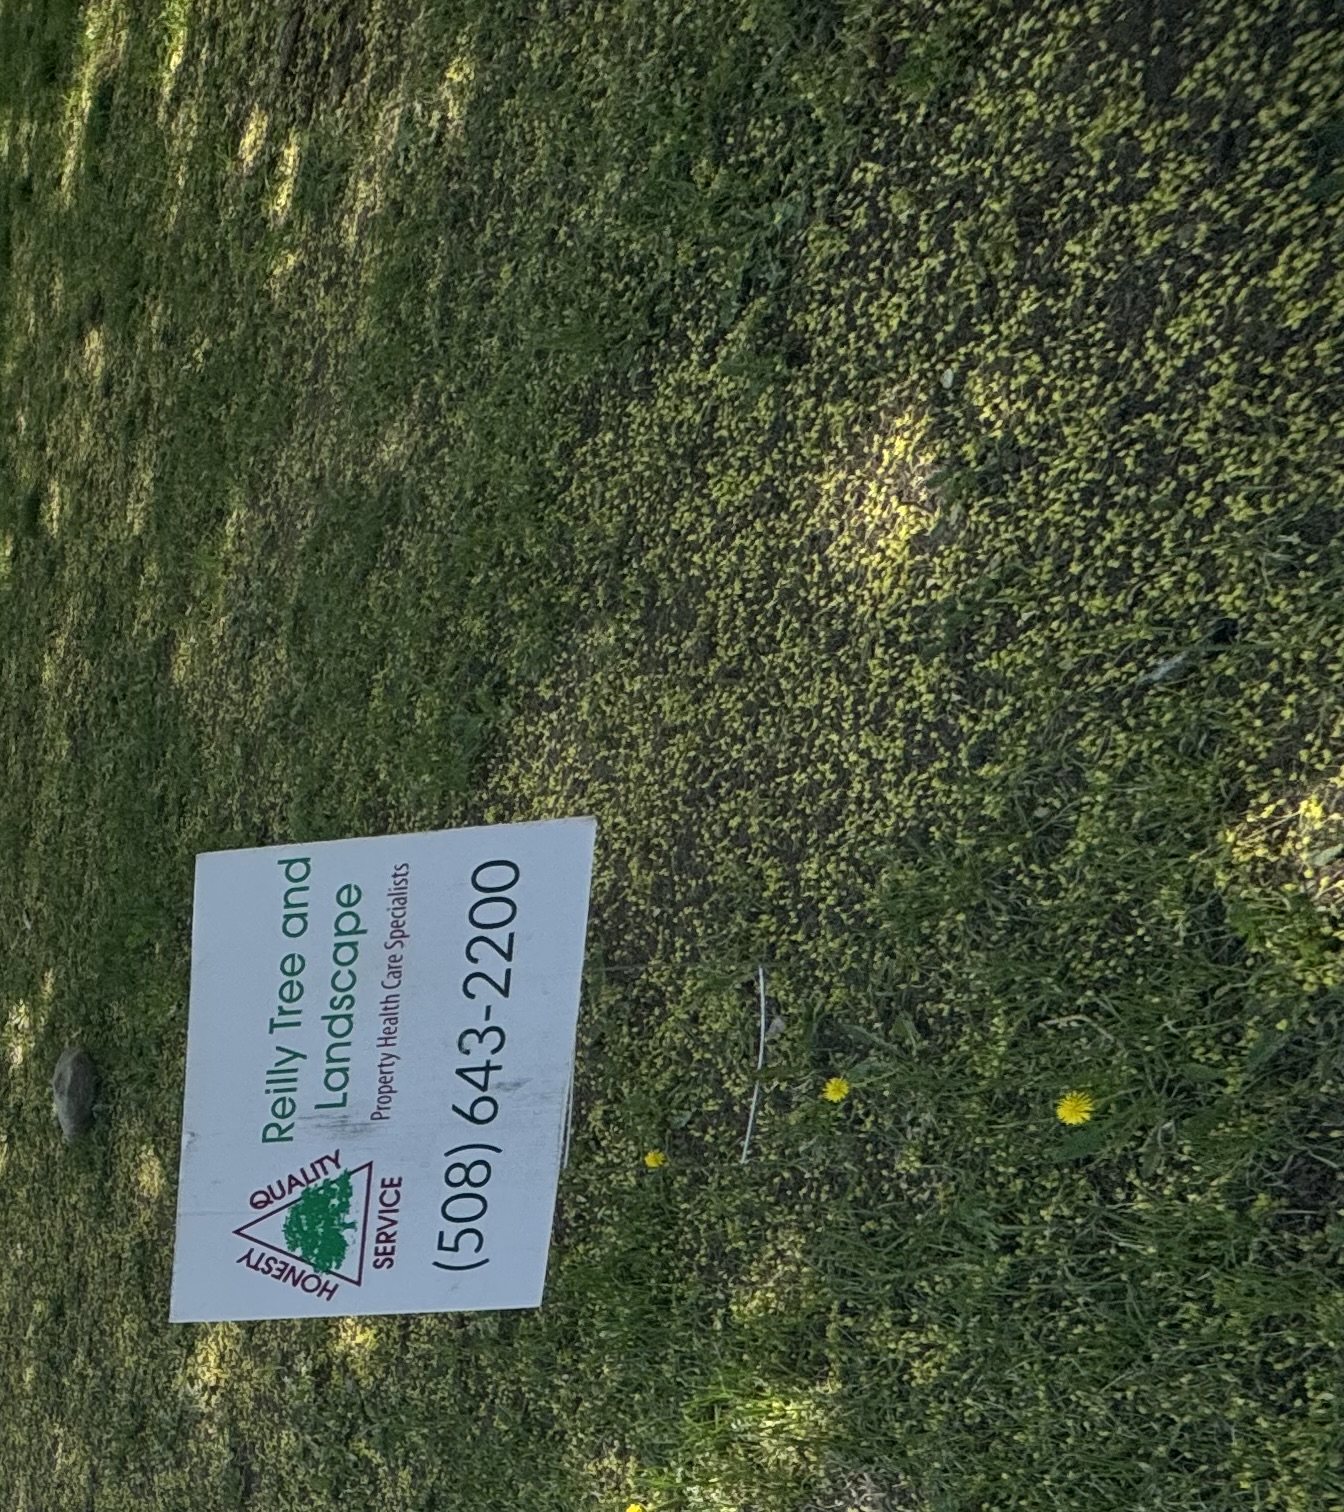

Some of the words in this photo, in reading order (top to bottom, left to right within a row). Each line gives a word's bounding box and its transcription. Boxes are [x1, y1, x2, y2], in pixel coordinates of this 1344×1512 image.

[276, 856, 312, 939] and
[384, 862, 411, 949] Specialists
[268, 952, 306, 1035] Tree
[314, 883, 369, 1110] Landscape
[381, 953, 404, 988] Care
[451, 859, 521, 1126] 643-2200
[376, 993, 401, 1048] Health
[262, 1045, 308, 1143] Reilly
[370, 1052, 398, 1121] Property
[249, 1148, 342, 1210] QUALITY
[431, 1143, 504, 1272] (508)
[372, 1175, 403, 1270] SERVICE
[235, 1247, 339, 1302] HONESTY
